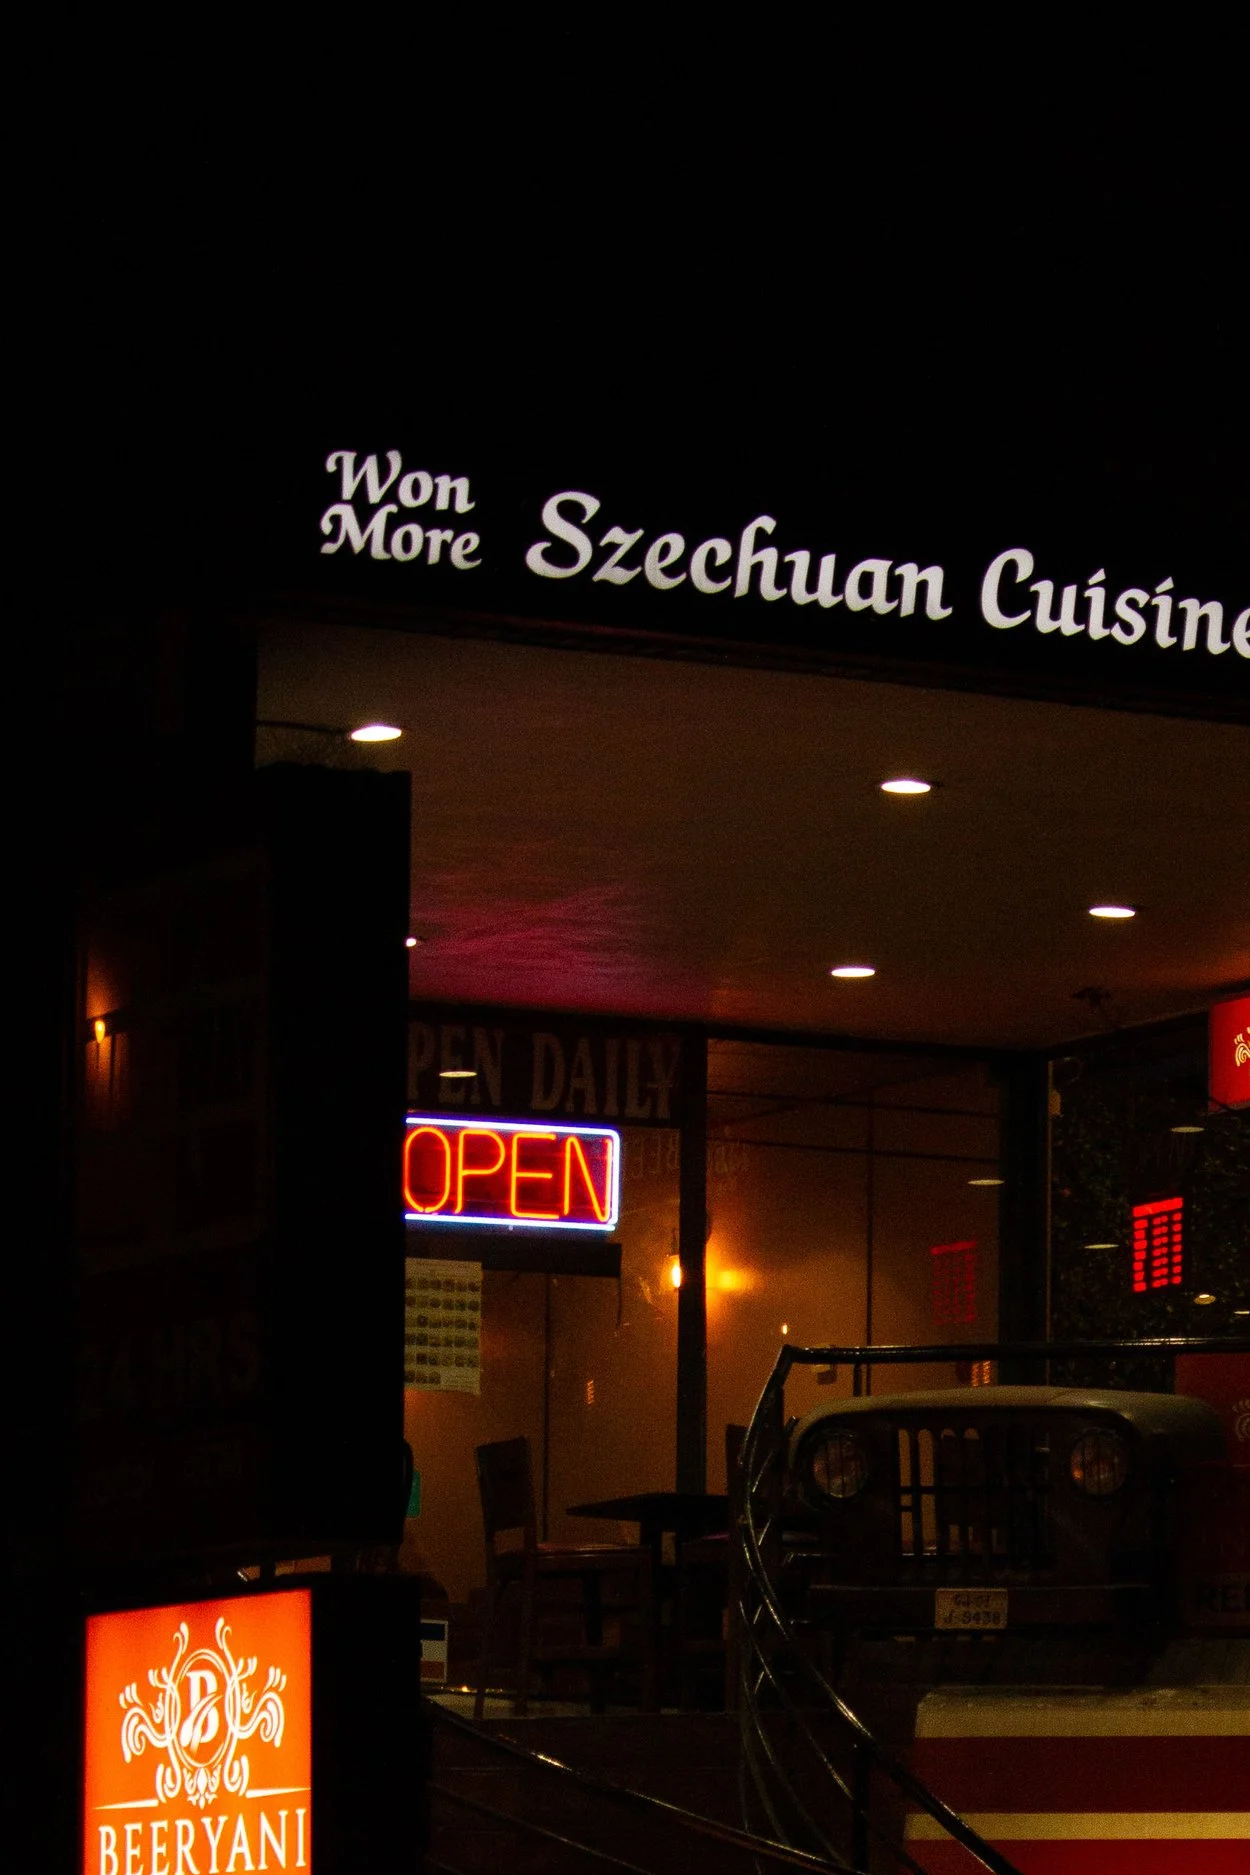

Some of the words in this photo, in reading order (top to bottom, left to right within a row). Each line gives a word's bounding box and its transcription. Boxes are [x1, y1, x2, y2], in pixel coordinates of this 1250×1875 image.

[325, 449, 476, 514] Won
[320, 503, 482, 570] More
[525, 491, 953, 621] Szechuan
[406, 1019, 505, 1106] PEN
[531, 1031, 684, 1120] DAILY
[403, 1126, 613, 1223] OPEN
